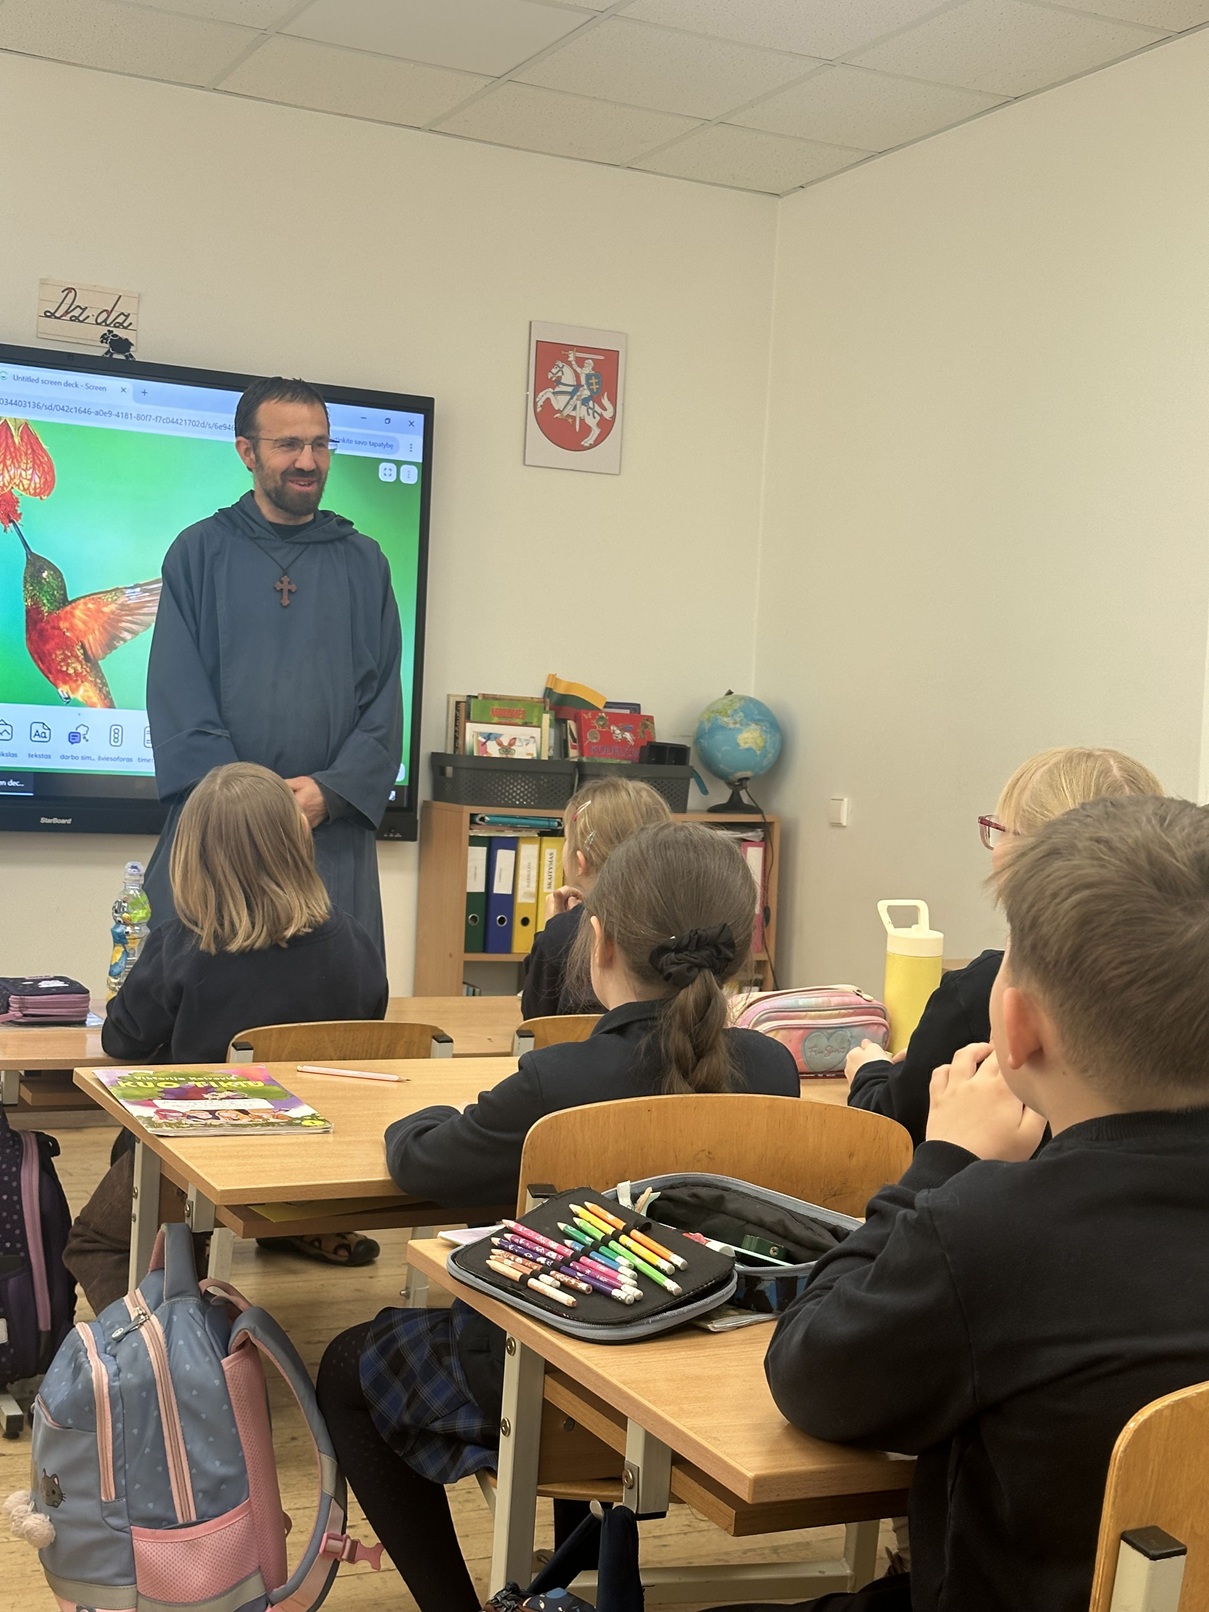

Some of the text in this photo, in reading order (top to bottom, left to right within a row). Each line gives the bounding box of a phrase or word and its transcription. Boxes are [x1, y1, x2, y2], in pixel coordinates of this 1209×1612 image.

[13, 374, 40, 384] Untitled
[63, 380, 80, 389] deck
[85, 382, 107, 391] Screen
[33, 730, 48, 739] Aa
[547, 851, 555, 890] SKAITYMAS
[117, 1081, 181, 1089] KUO
